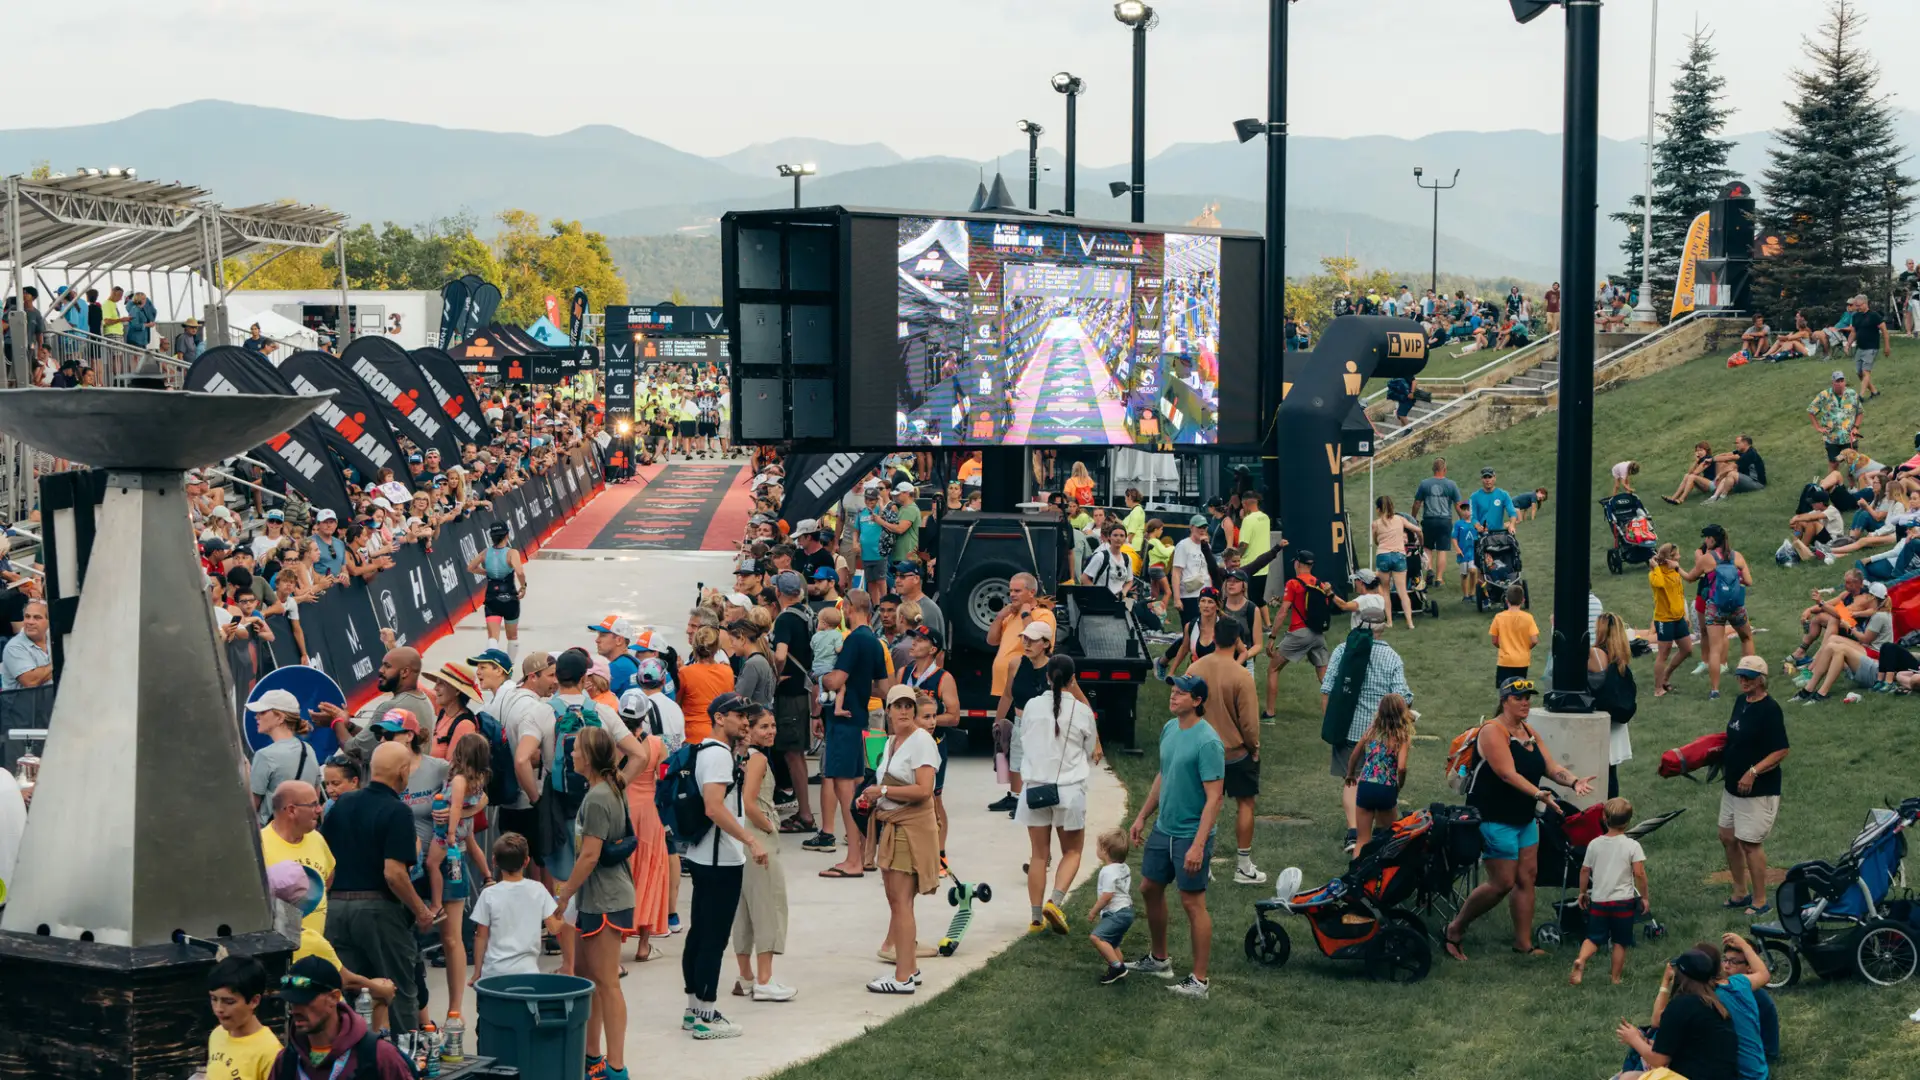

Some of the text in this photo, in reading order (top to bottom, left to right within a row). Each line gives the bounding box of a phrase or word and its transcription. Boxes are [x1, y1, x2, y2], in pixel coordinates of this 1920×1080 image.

[1404, 338, 1422, 353] VIP
[203, 371, 324, 483] IRAN
[351, 356, 441, 440] IRONMAN
[419, 364, 481, 440] RONMAN
[1325, 443, 1345, 553] VIP
